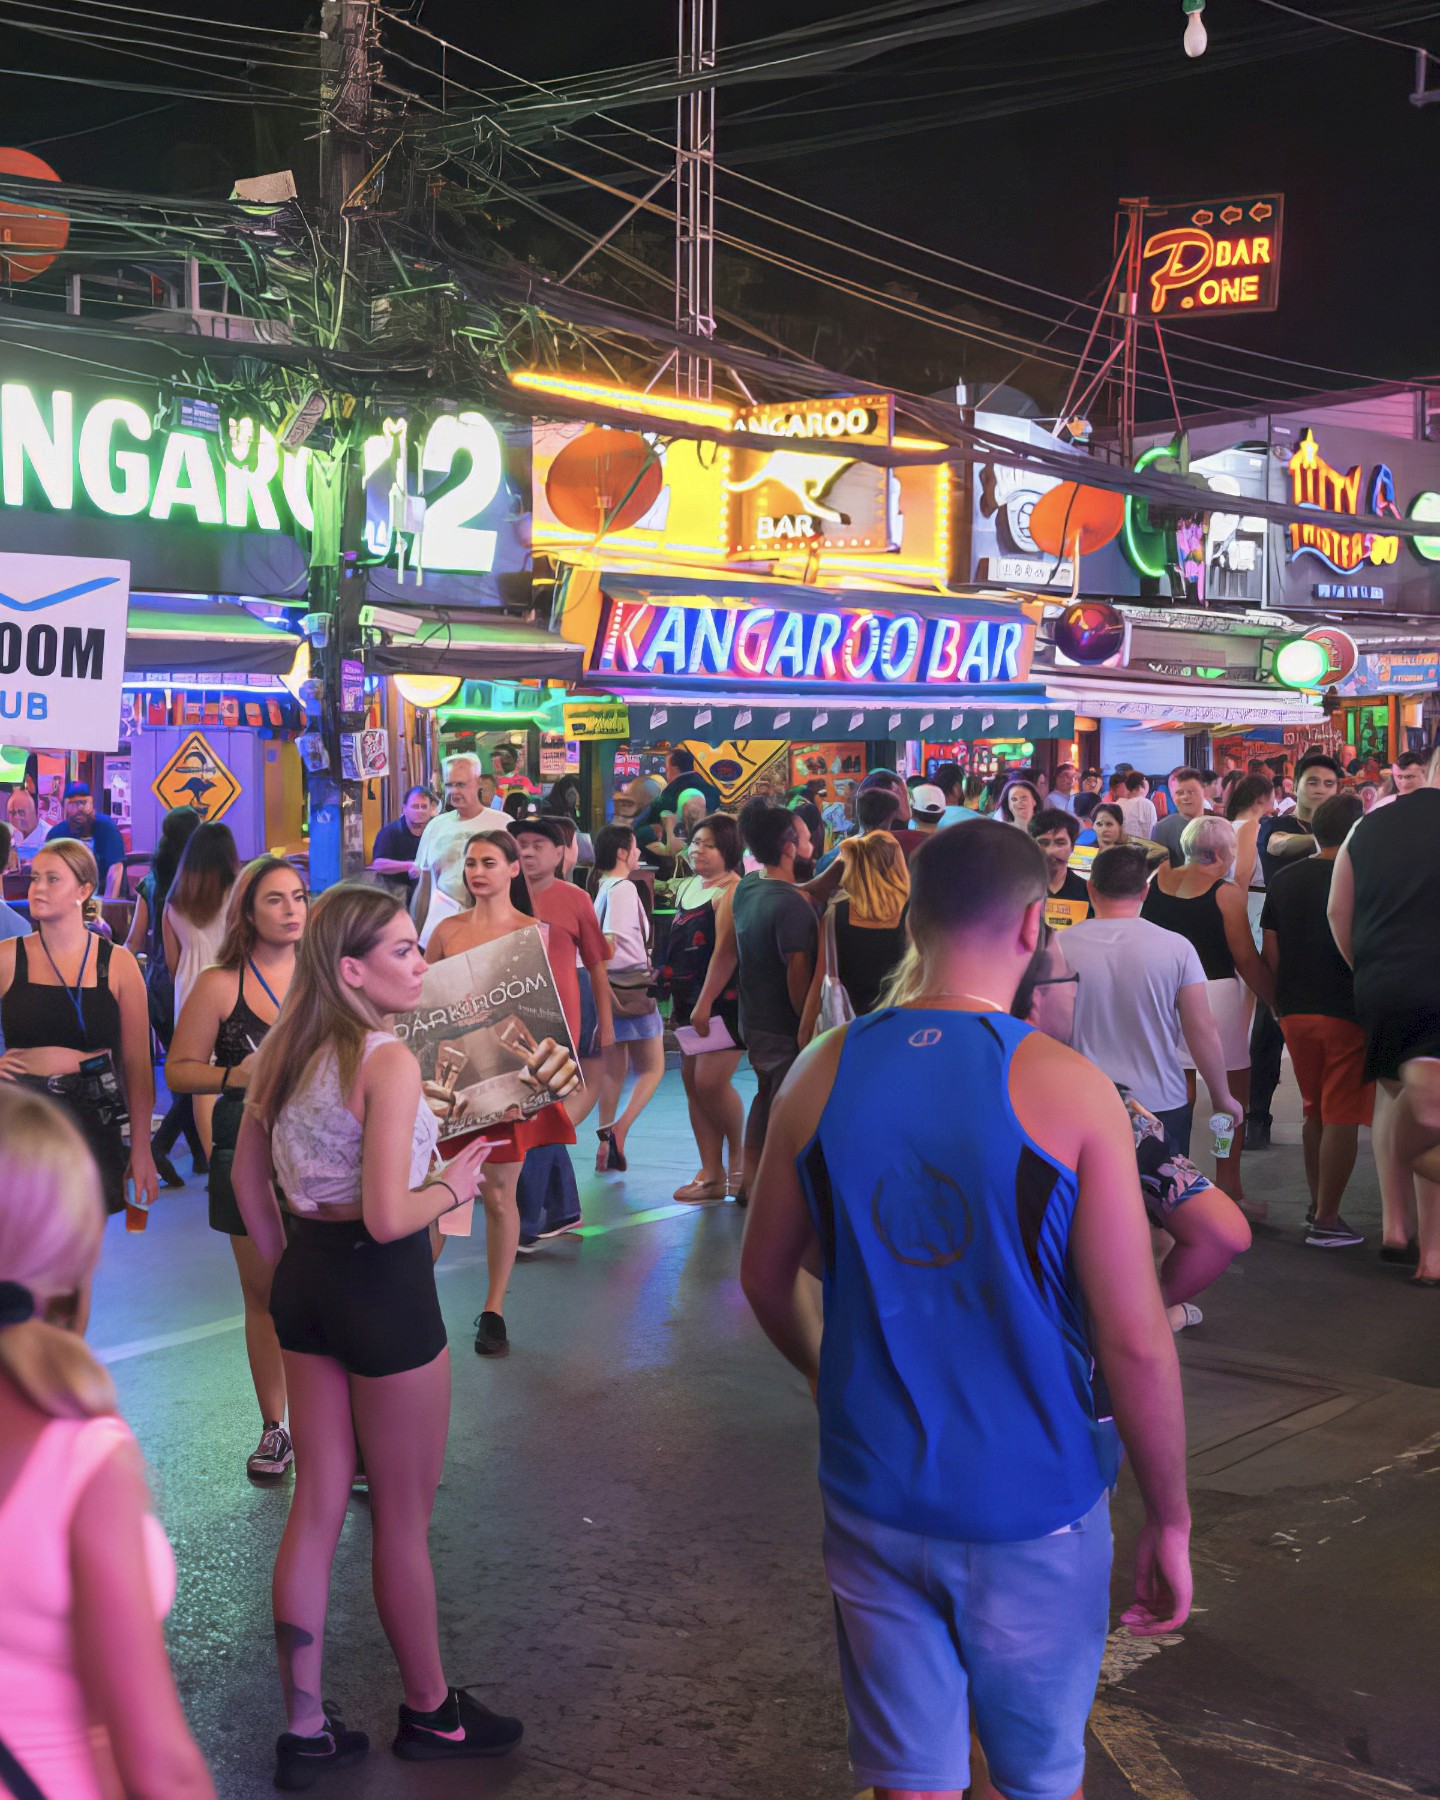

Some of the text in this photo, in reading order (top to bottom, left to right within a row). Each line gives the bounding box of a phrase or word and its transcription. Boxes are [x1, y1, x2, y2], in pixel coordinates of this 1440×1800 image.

[730, 408, 869, 438] ANGAROO
[409, 411, 503, 573] 2
[756, 513, 816, 540] BAR
[600, 600, 1023, 684] KANGAROO BAR
